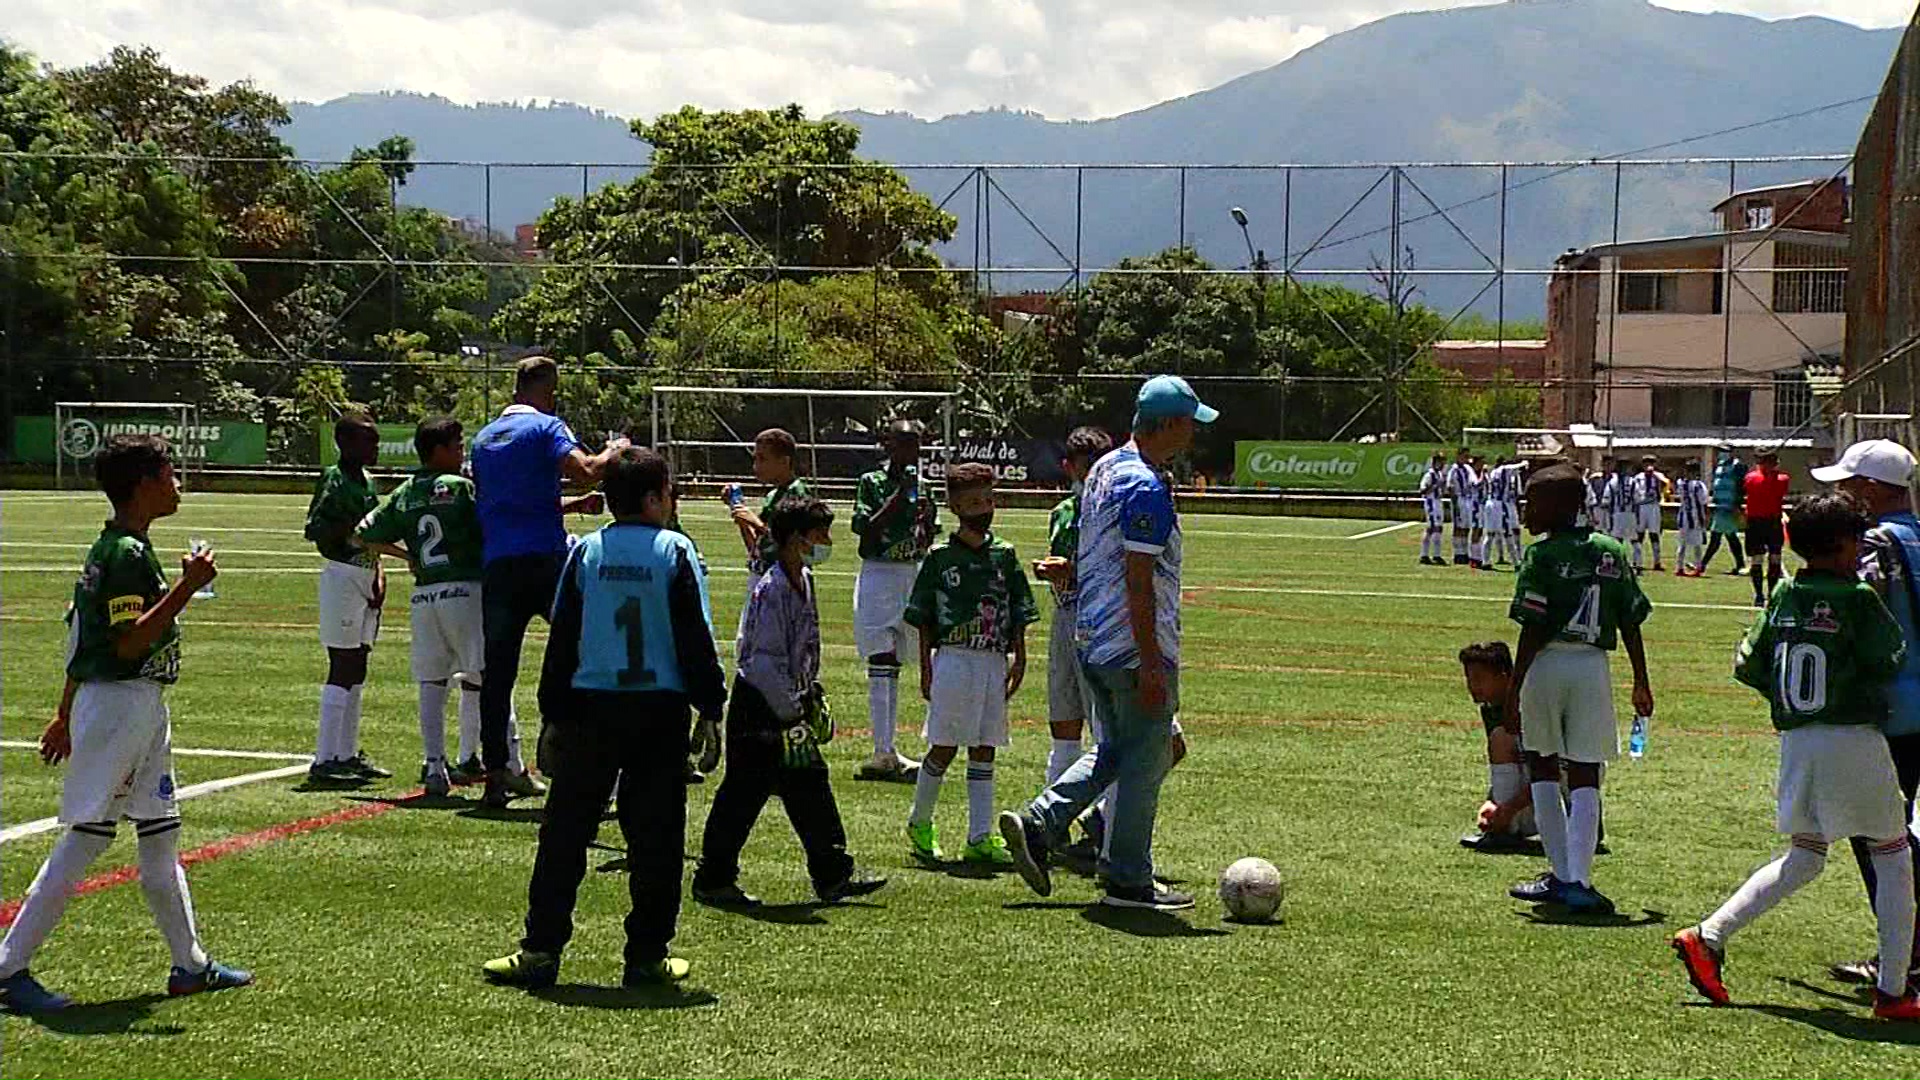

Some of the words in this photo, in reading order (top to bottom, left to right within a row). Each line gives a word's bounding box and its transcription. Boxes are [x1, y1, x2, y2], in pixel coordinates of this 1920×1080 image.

[998, 441, 1019, 460] de
[1250, 451, 1358, 476] Colanta
[417, 514, 450, 568] 2
[614, 596, 657, 686] 1
[1562, 584, 1601, 643] 4
[1773, 641, 1827, 715] 10
